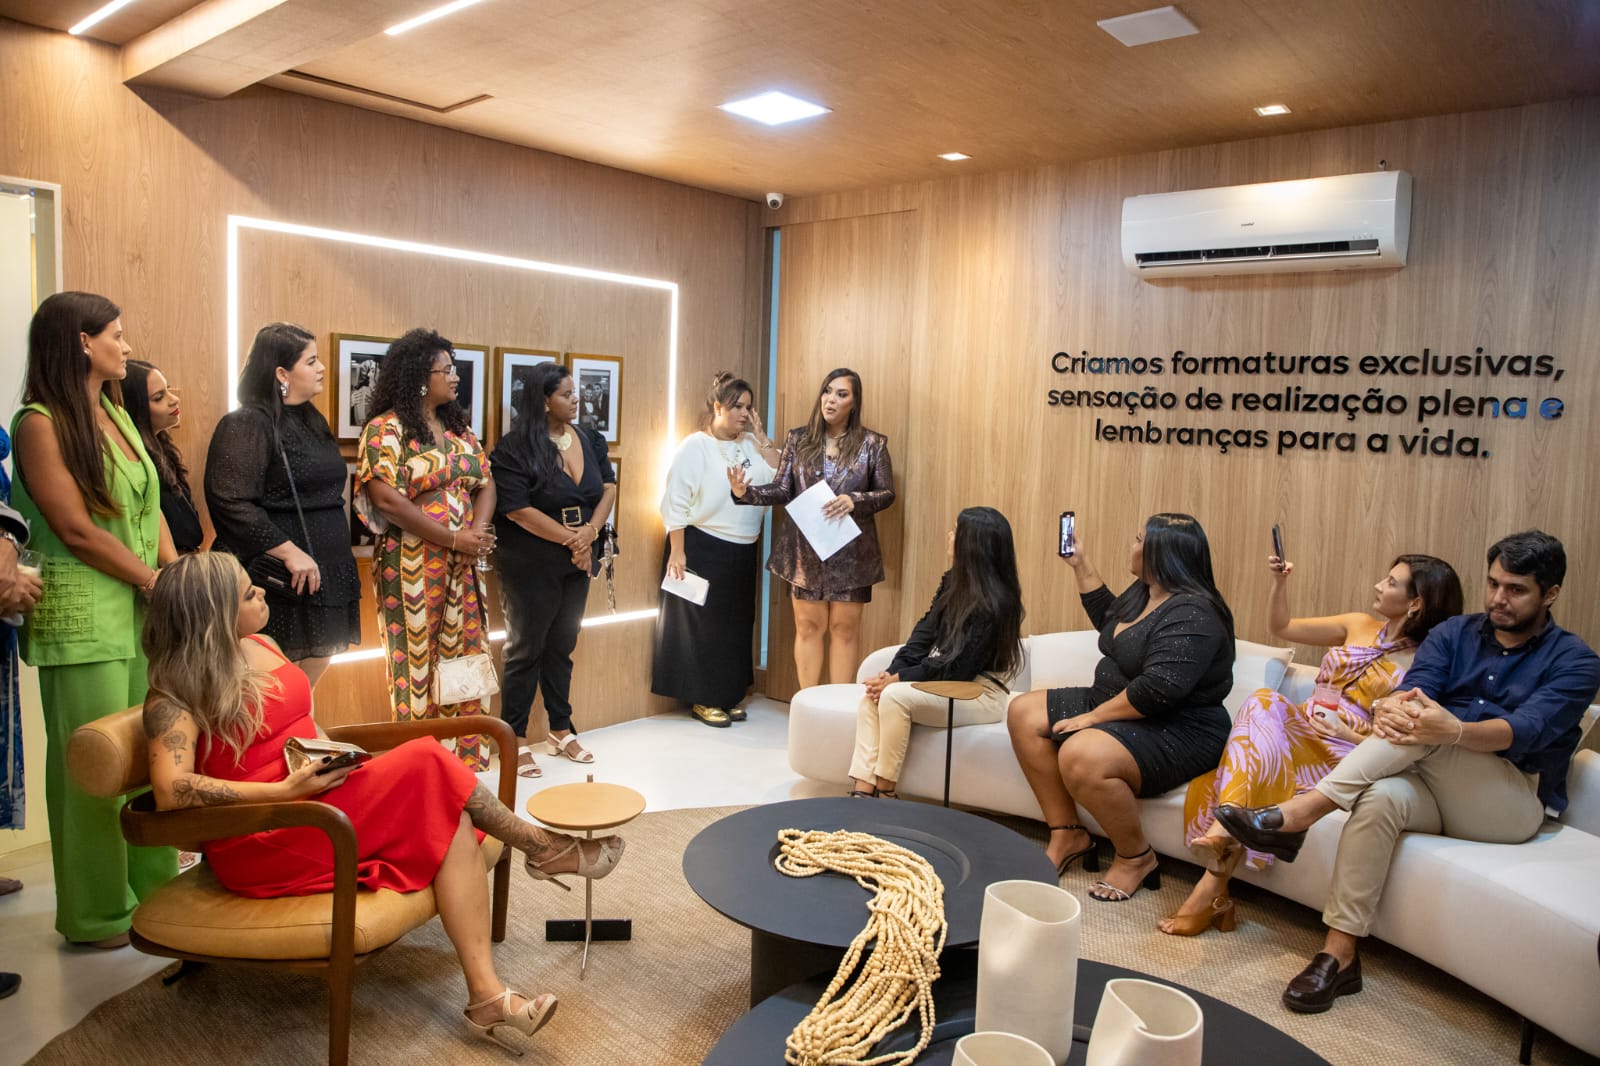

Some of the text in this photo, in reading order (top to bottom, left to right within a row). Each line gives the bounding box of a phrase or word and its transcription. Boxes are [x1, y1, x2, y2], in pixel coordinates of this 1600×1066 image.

[1051, 348, 1565, 381] Criamos formaturas exclusivas,
[1047, 386, 1565, 423] sensação de realização plena e
[1094, 419, 1490, 459] lembranças para a vida.
